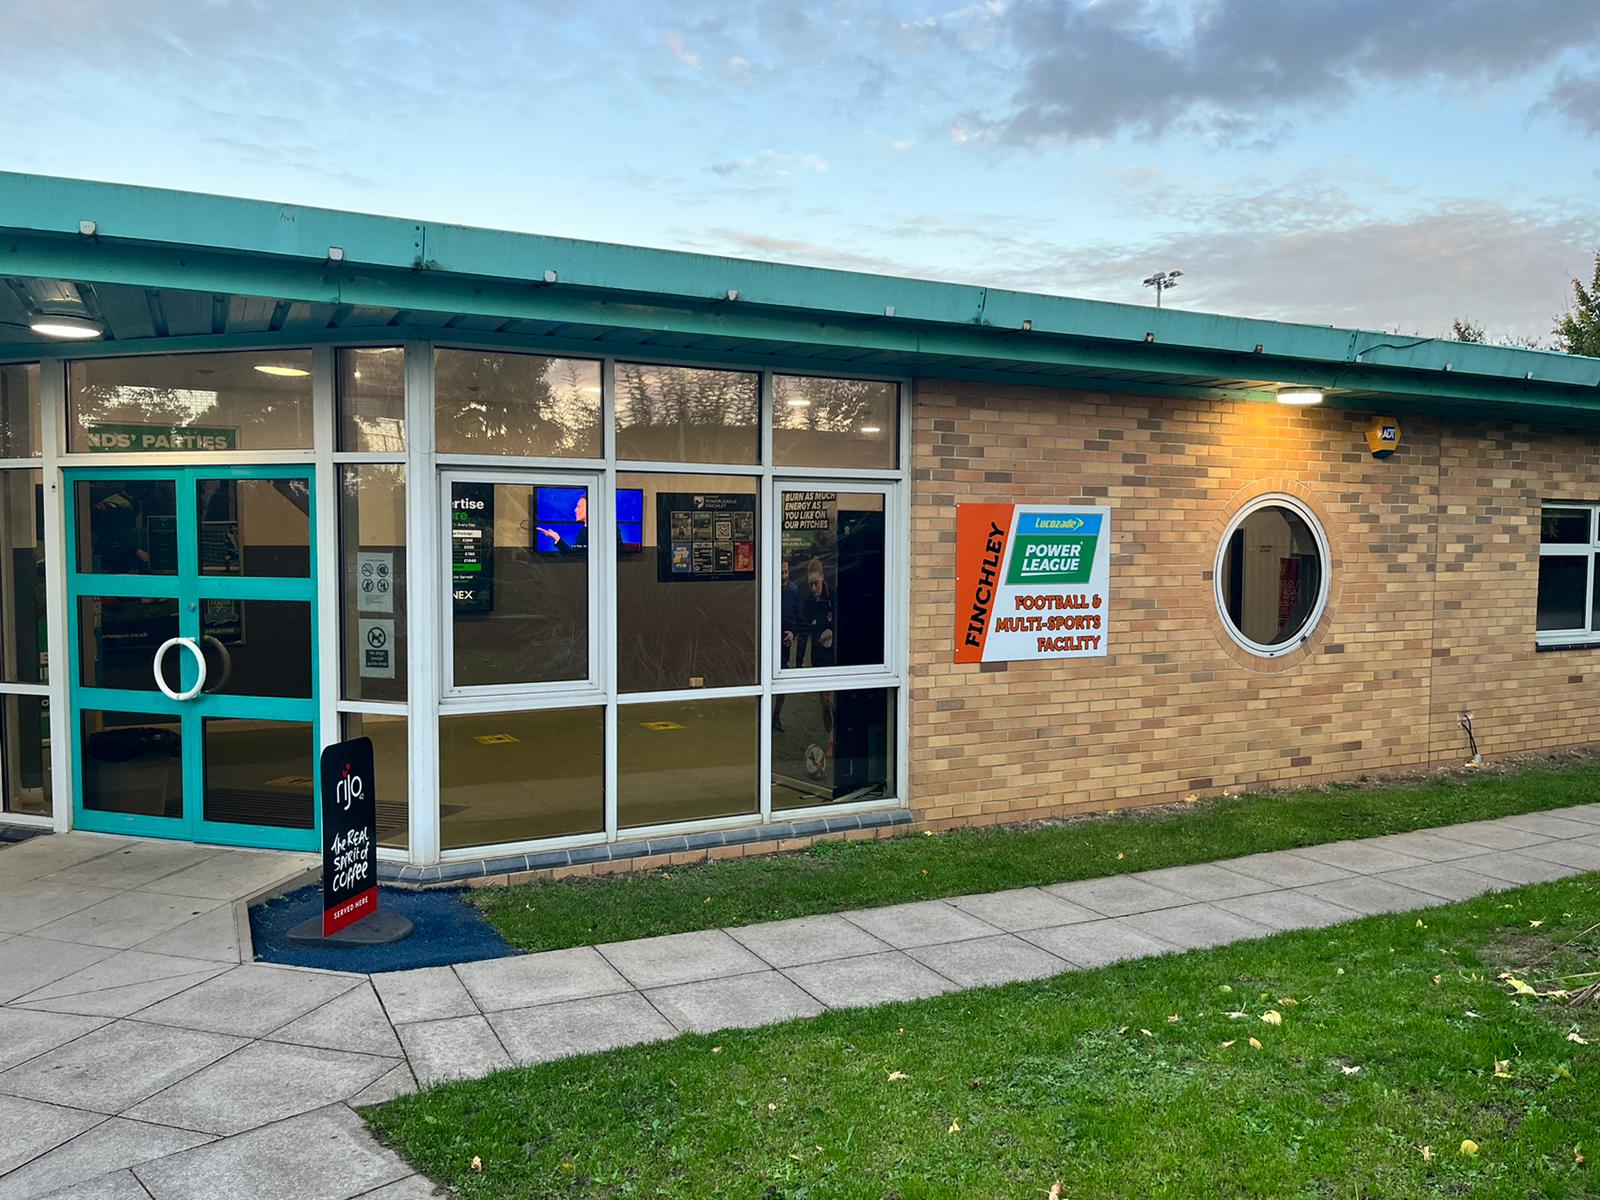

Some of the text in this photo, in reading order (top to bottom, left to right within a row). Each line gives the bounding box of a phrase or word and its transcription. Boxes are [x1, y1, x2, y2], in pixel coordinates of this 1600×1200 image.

[1381, 428, 1396, 439] ADT
[142, 434, 228, 449] PARTIES
[785, 492, 836, 501] BURN AS MUCH
[452, 498, 485, 509] rtise
[785, 501, 822, 511] ENERGY AS
[785, 511, 826, 520] YOU LIKE ON
[784, 520, 828, 529] OUR PITCHES
[1035, 517, 1076, 529] Lucozade
[1025, 544, 1081, 557] POWER
[1021, 558, 1079, 571] LEAGUE
[965, 522, 1005, 647] FINCHLEY
[1015, 594, 1102, 610] FOOTBALL &
[995, 615, 1101, 632] MULTI-SPORTS
[1037, 635, 1101, 652] FACILITY
[360, 841, 370, 860] of
[333, 896, 369, 920] SERVED HERE
